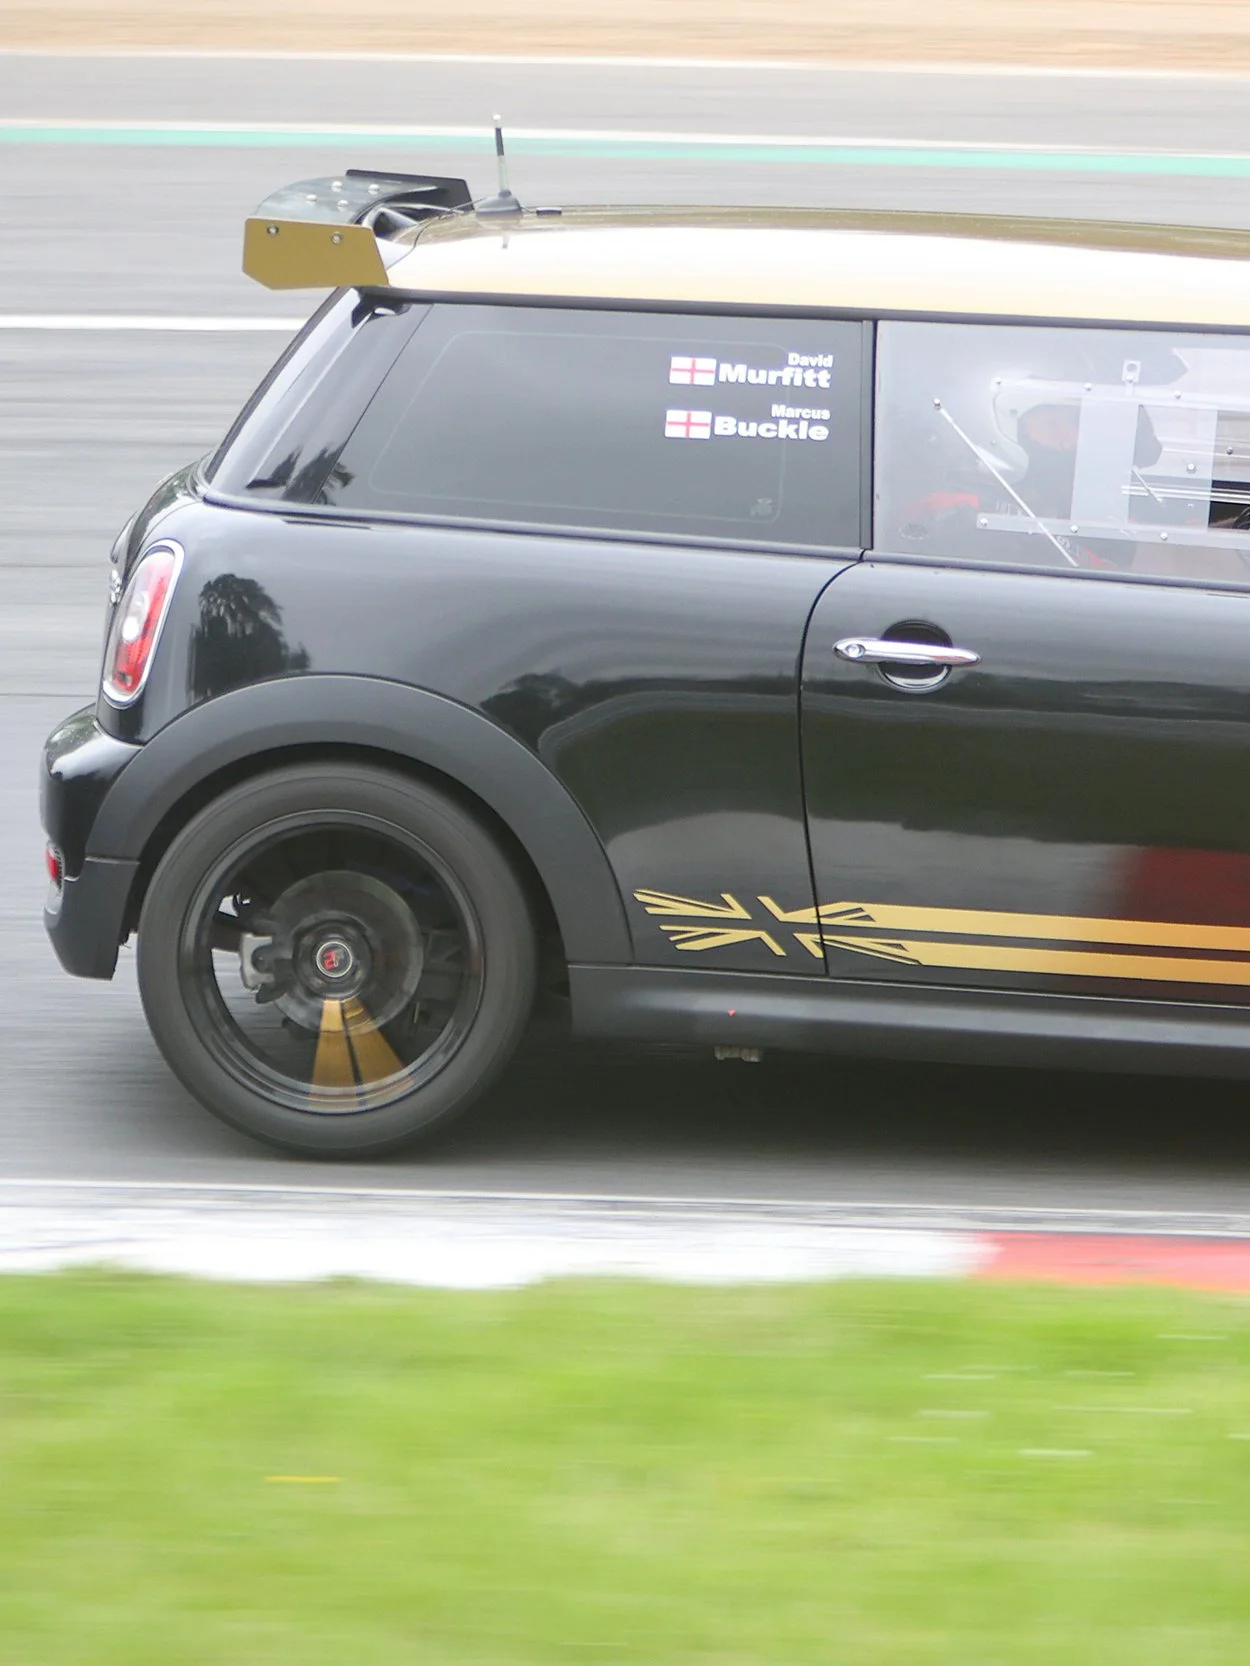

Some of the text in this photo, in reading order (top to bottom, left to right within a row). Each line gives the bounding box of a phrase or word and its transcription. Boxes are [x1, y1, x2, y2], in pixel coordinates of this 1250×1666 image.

[788, 352, 833, 368] David
[718, 363, 831, 388] Murfitt
[771, 404, 831, 420] Marcus
[714, 415, 830, 441] Buckle
